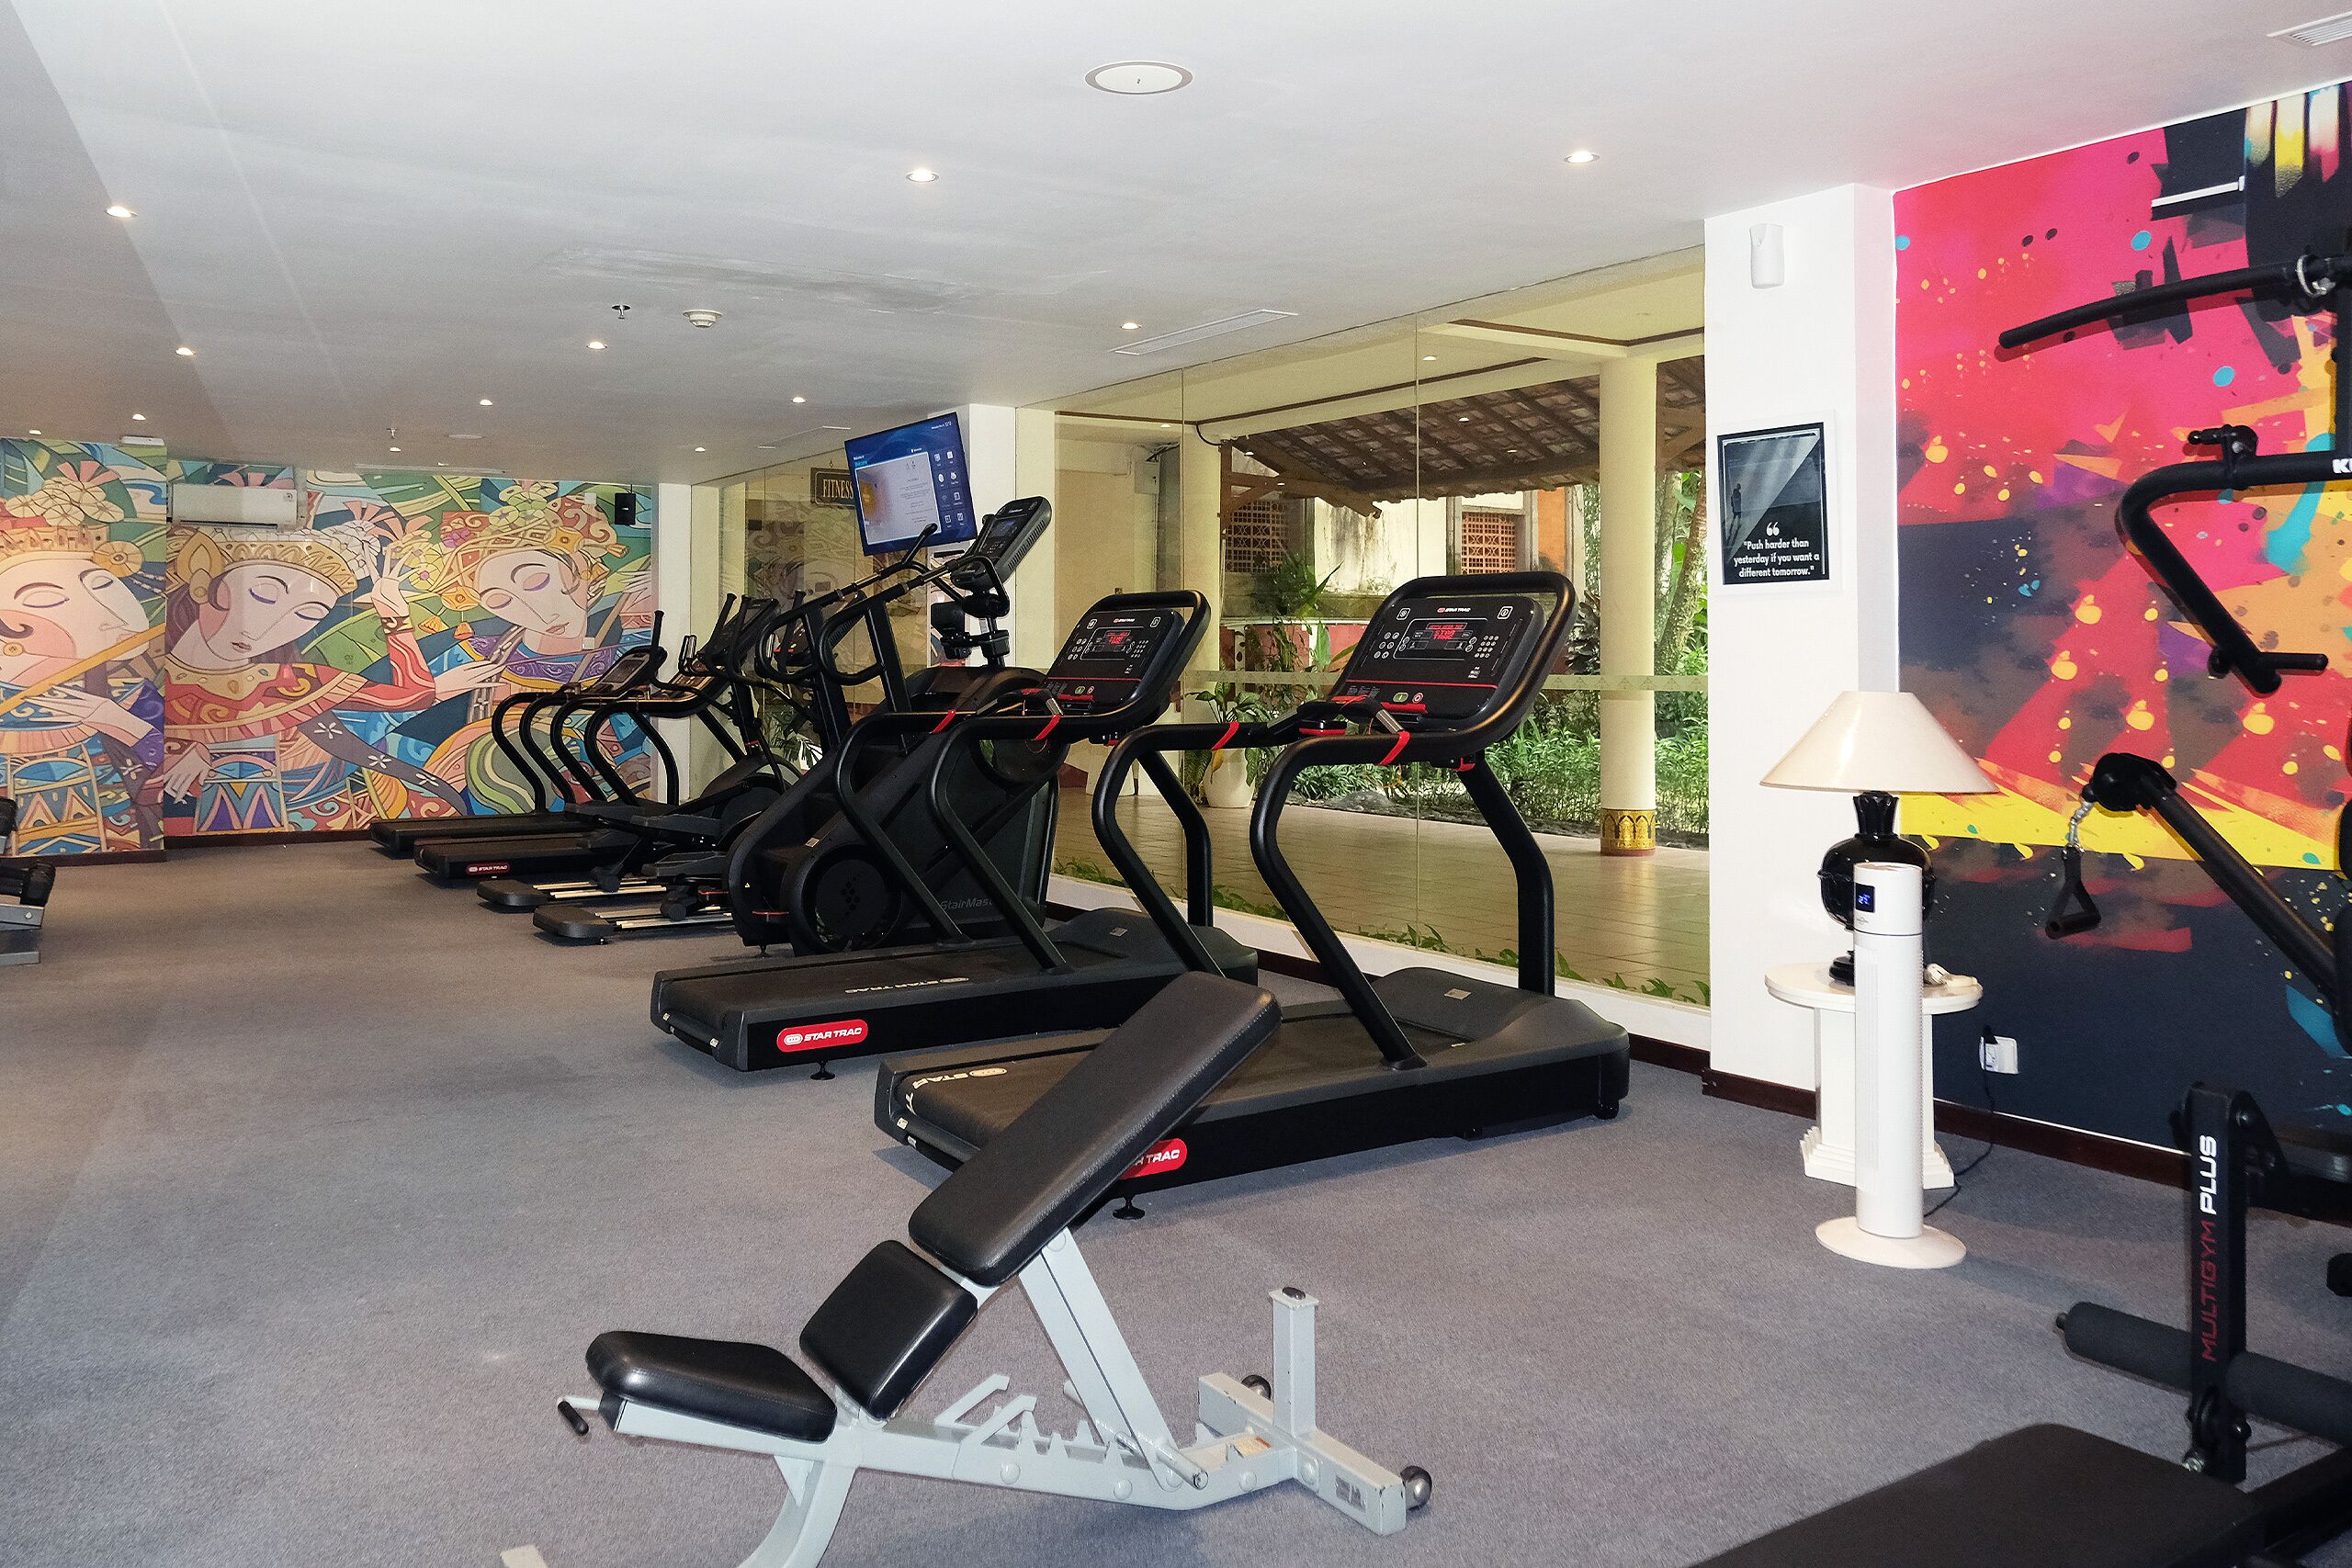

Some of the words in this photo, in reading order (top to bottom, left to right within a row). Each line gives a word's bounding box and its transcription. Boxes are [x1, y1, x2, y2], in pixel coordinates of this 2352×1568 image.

[822, 479, 854, 499] FITNESS
[1744, 540, 1763, 550] "Push
[1765, 538, 1790, 549] harder
[1792, 537, 1809, 548] than
[1734, 553, 1770, 567] yesterday
[1770, 552, 1777, 562] if
[1778, 554, 1792, 566] you
[1792, 552, 1812, 562] want
[1739, 567, 1770, 578] different
[1772, 565, 1815, 576] tomorrow."
[803, 1031, 833, 1042] STAR
[833, 1027, 863, 1038] TRAC
[1146, 1149, 1180, 1164] TRAC
[2199, 1134, 2218, 1215] PLUS
[2200, 1219, 2218, 1362] MULTIGYM
